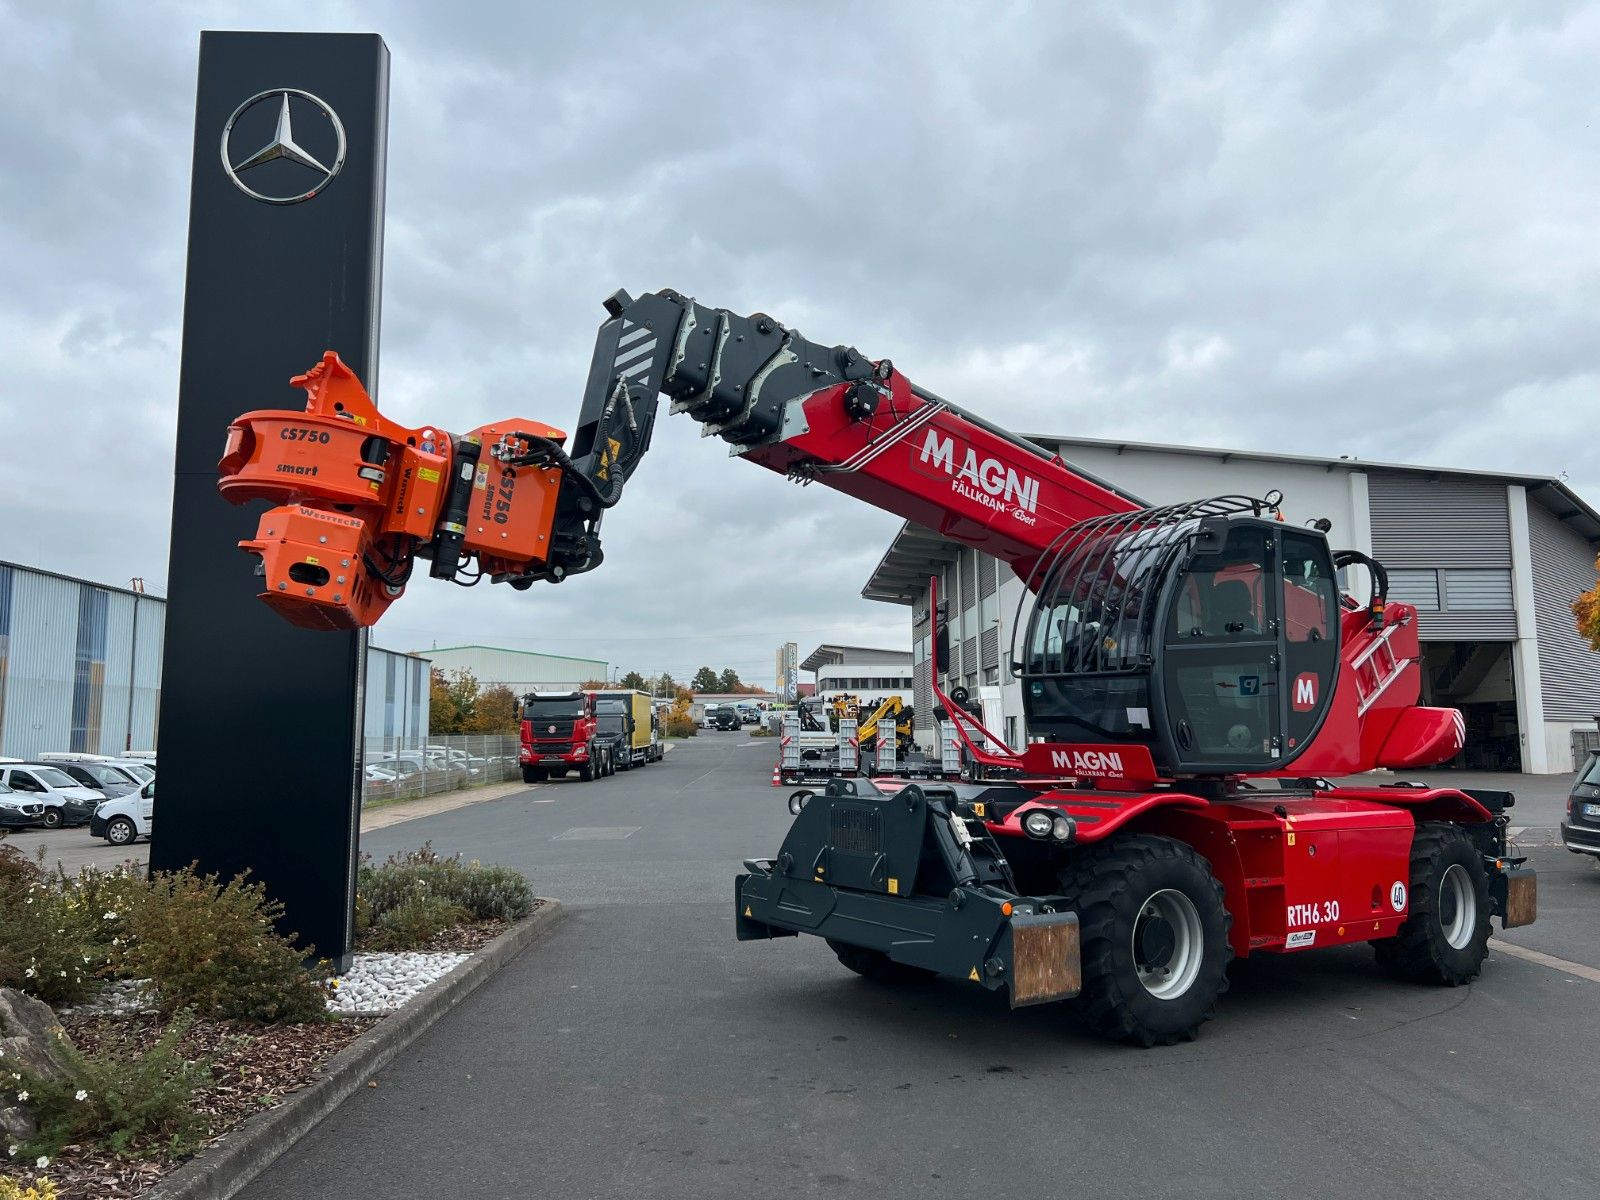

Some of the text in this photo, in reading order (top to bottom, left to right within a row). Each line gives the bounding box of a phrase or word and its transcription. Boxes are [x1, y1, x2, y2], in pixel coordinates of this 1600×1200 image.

[281, 428, 330, 444] CS750
[276, 464, 318, 476] smart
[920, 429, 1040, 513] MAGNI
[483, 484, 495, 520] smart
[494, 467, 517, 524] CS750
[1297, 679, 1315, 704] M
[1051, 751, 1123, 771] MAGNI
[1393, 887, 1403, 906] 40
[1287, 900, 1340, 927] RTH6.30
